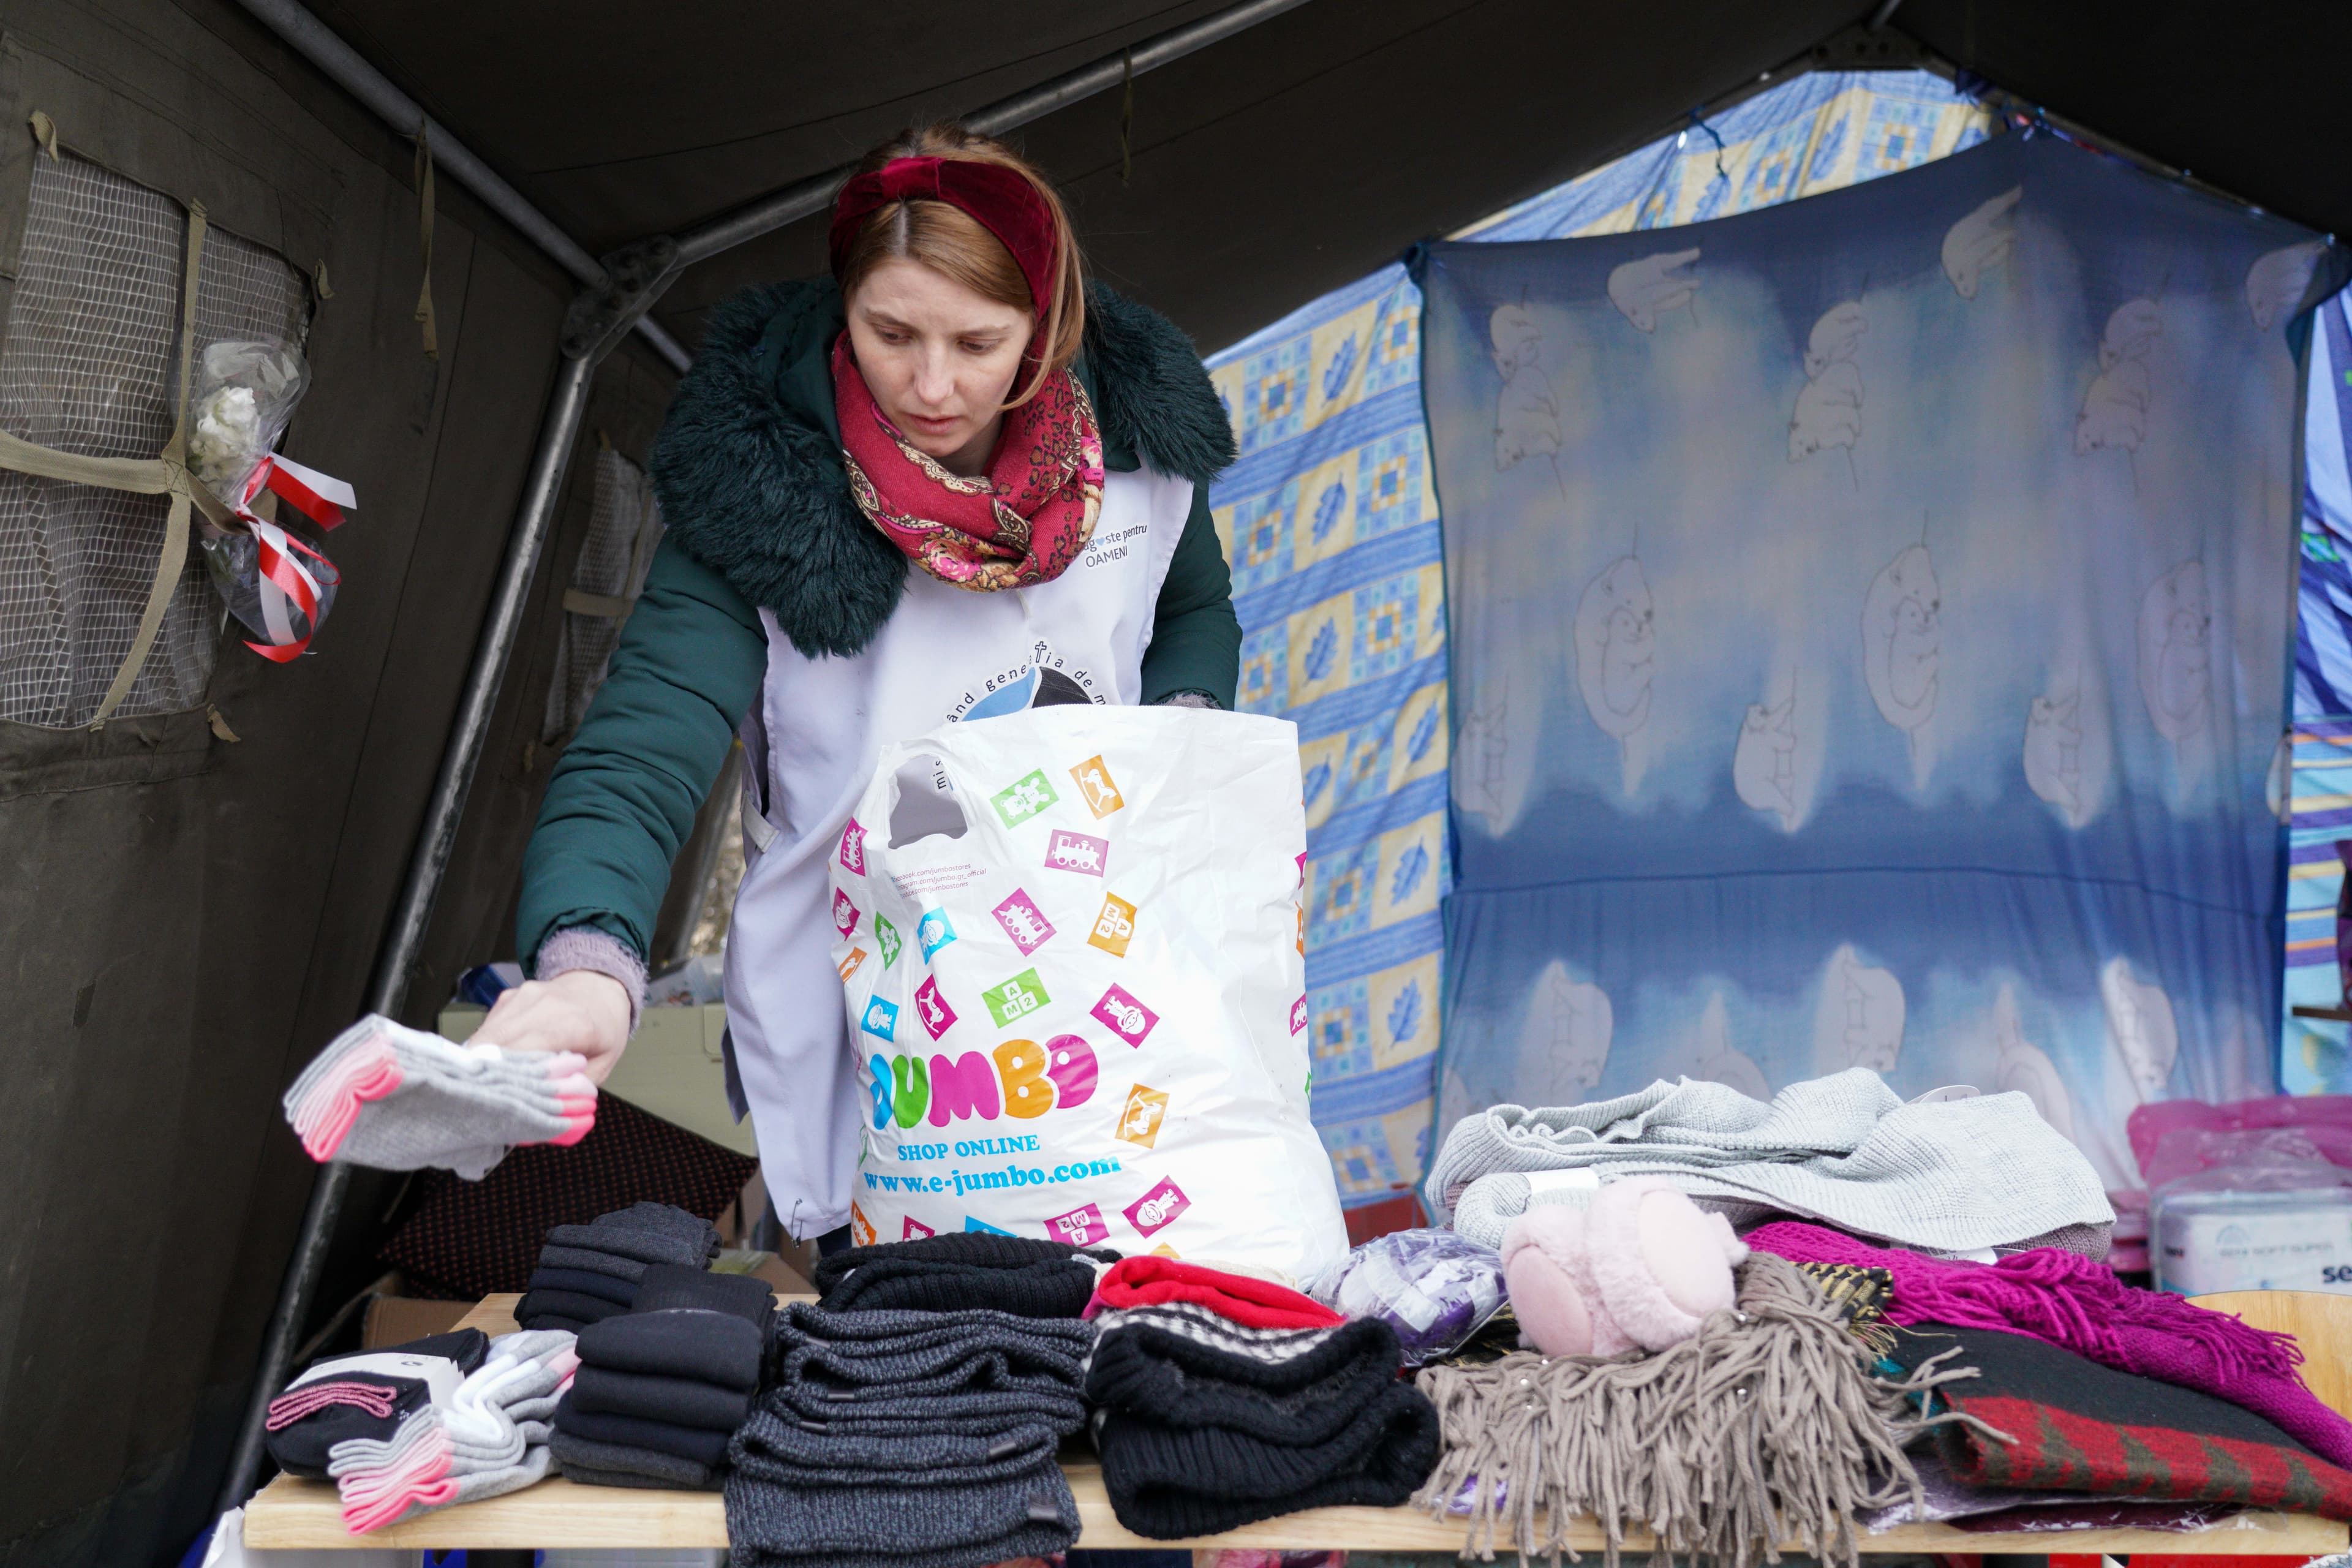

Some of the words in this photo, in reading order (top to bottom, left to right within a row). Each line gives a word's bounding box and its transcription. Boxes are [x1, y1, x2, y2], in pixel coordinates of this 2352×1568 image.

[1123, 525, 1147, 543] pentru
[1085, 545, 1128, 568] OAMENI
[1074, 670, 1093, 688] de
[1107, 907, 1117, 918] M
[1101, 924, 1110, 933] 2
[1118, 922, 1128, 931] A
[1009, 986, 1017, 997] A
[1006, 1004, 1017, 1016] M
[1023, 997, 1033, 1006] 2
[869, 1034, 1099, 1131] JUMBO
[897, 1143, 949, 1162] SHOP
[954, 1134, 1041, 1158] ONLINE
[864, 1156, 1122, 1196] www.e-jumbo.com
